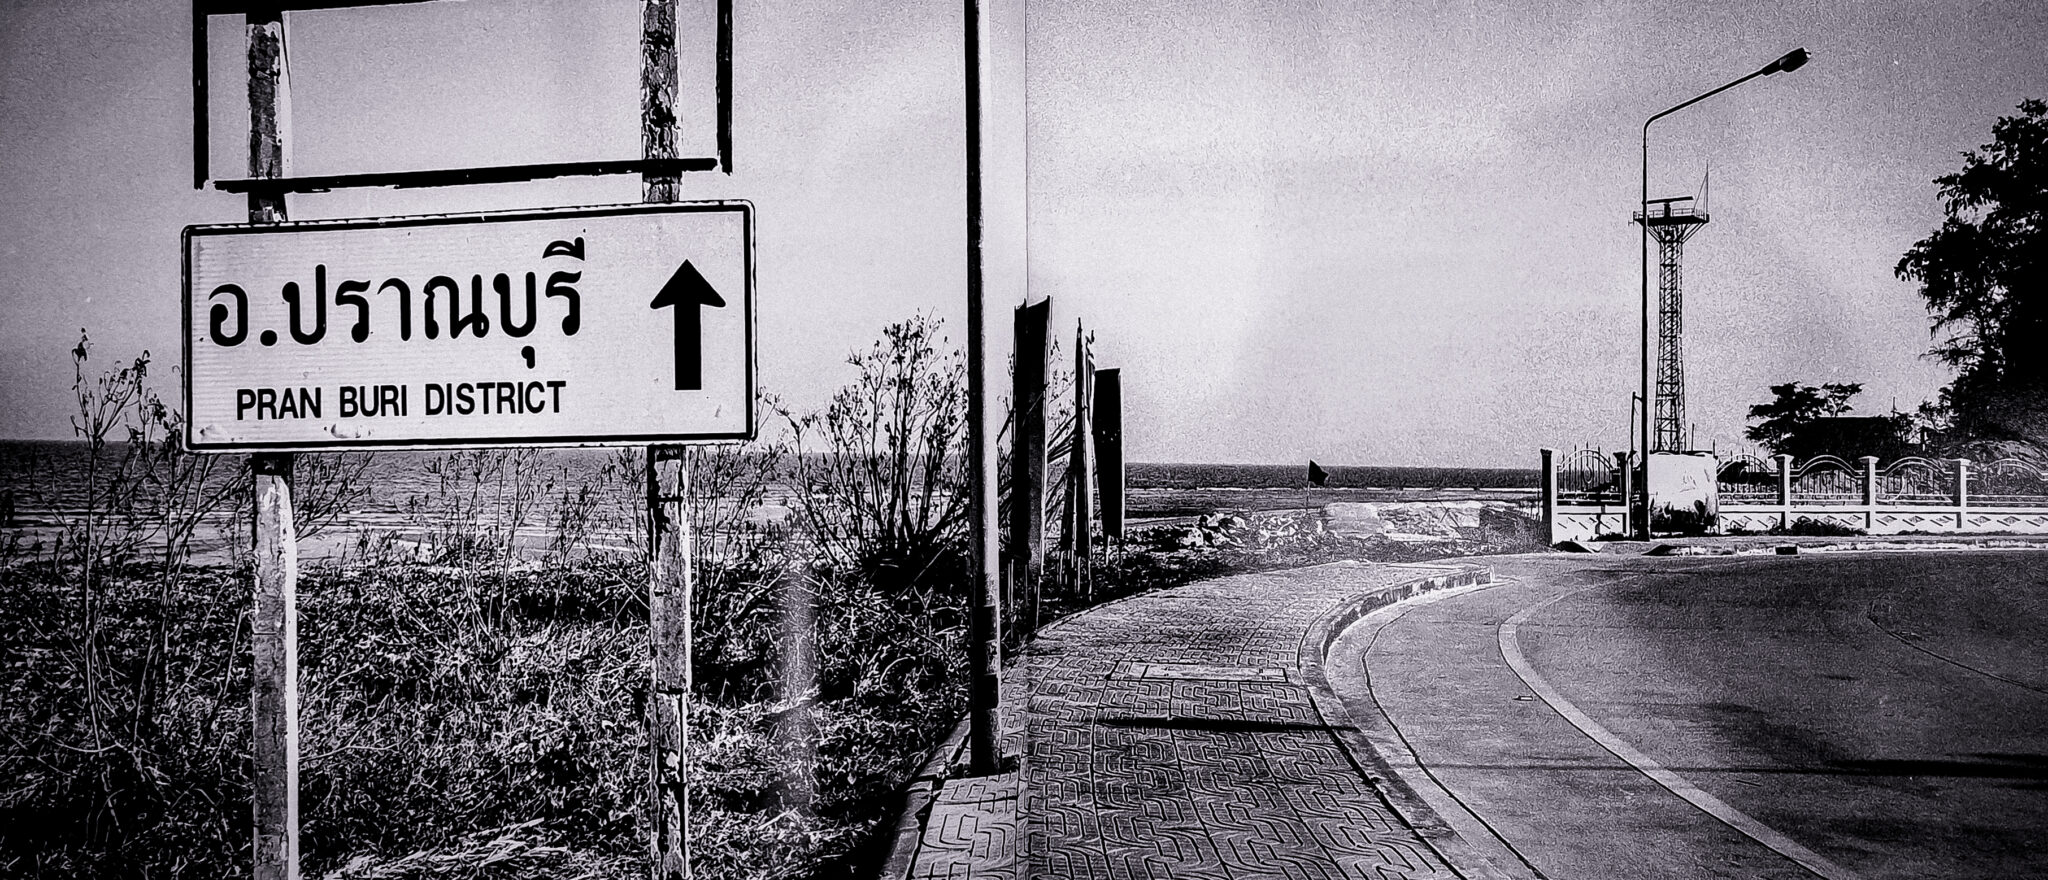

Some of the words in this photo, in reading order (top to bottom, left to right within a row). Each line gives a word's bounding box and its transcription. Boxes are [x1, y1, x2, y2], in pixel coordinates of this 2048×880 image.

[208, 236, 586, 369] อ.ปราณบุรี
[236, 387, 322, 421] PRAN
[339, 385, 408, 418] BURI
[425, 380, 567, 417] DISTRICT
